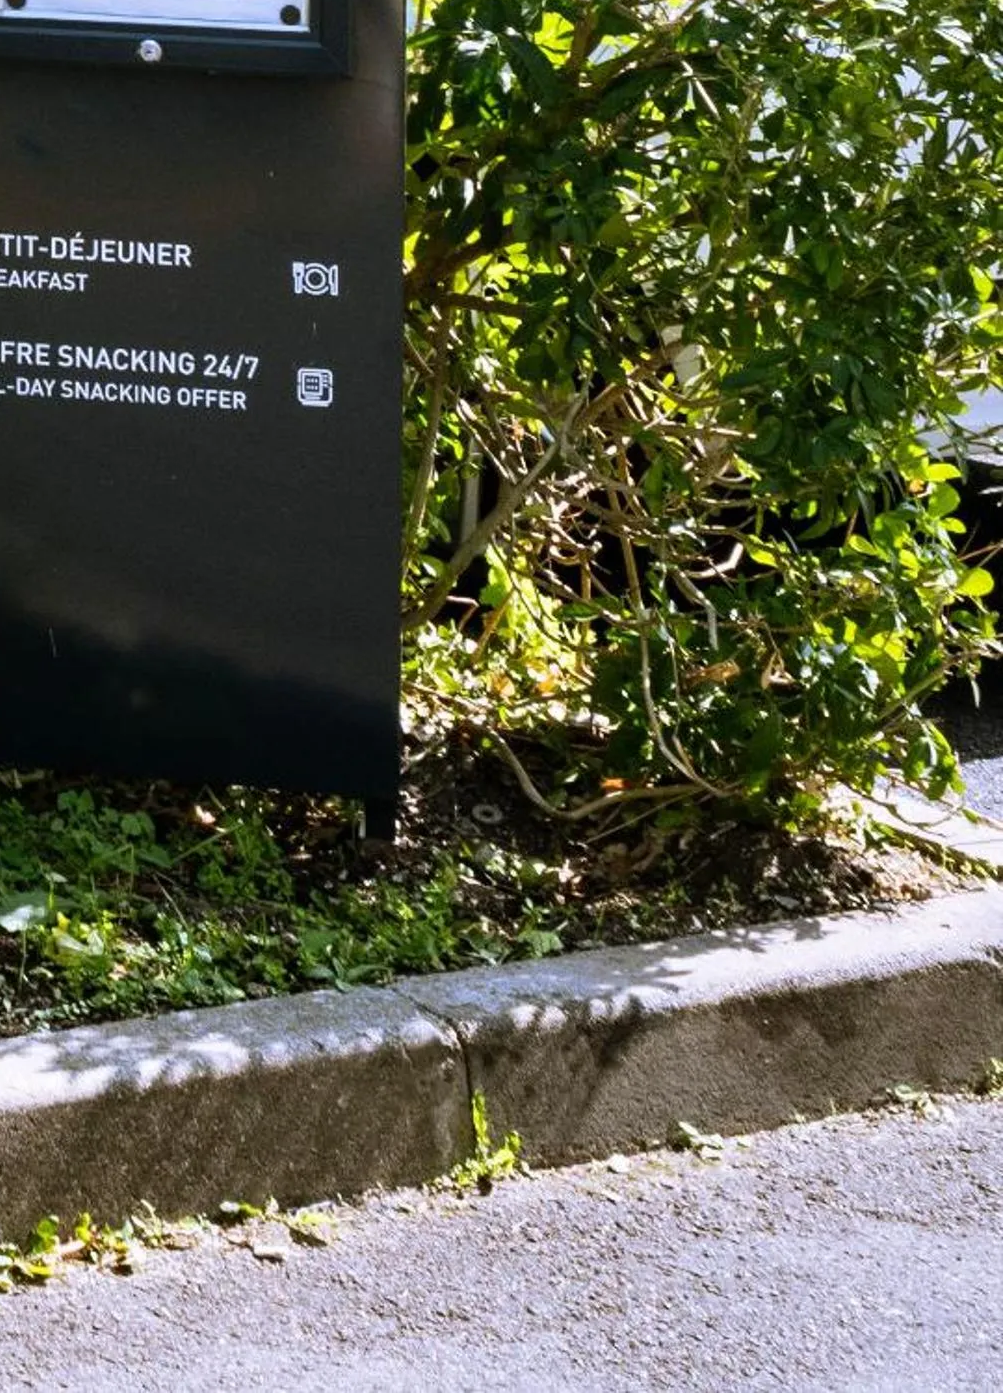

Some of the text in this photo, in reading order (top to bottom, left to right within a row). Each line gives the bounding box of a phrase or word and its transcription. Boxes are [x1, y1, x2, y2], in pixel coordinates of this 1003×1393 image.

[57, 344, 196, 376] SNACKING
[202, 353, 259, 381] 24/7
[60, 379, 172, 405] SNACKING
[176, 387, 247, 411] OFFER
